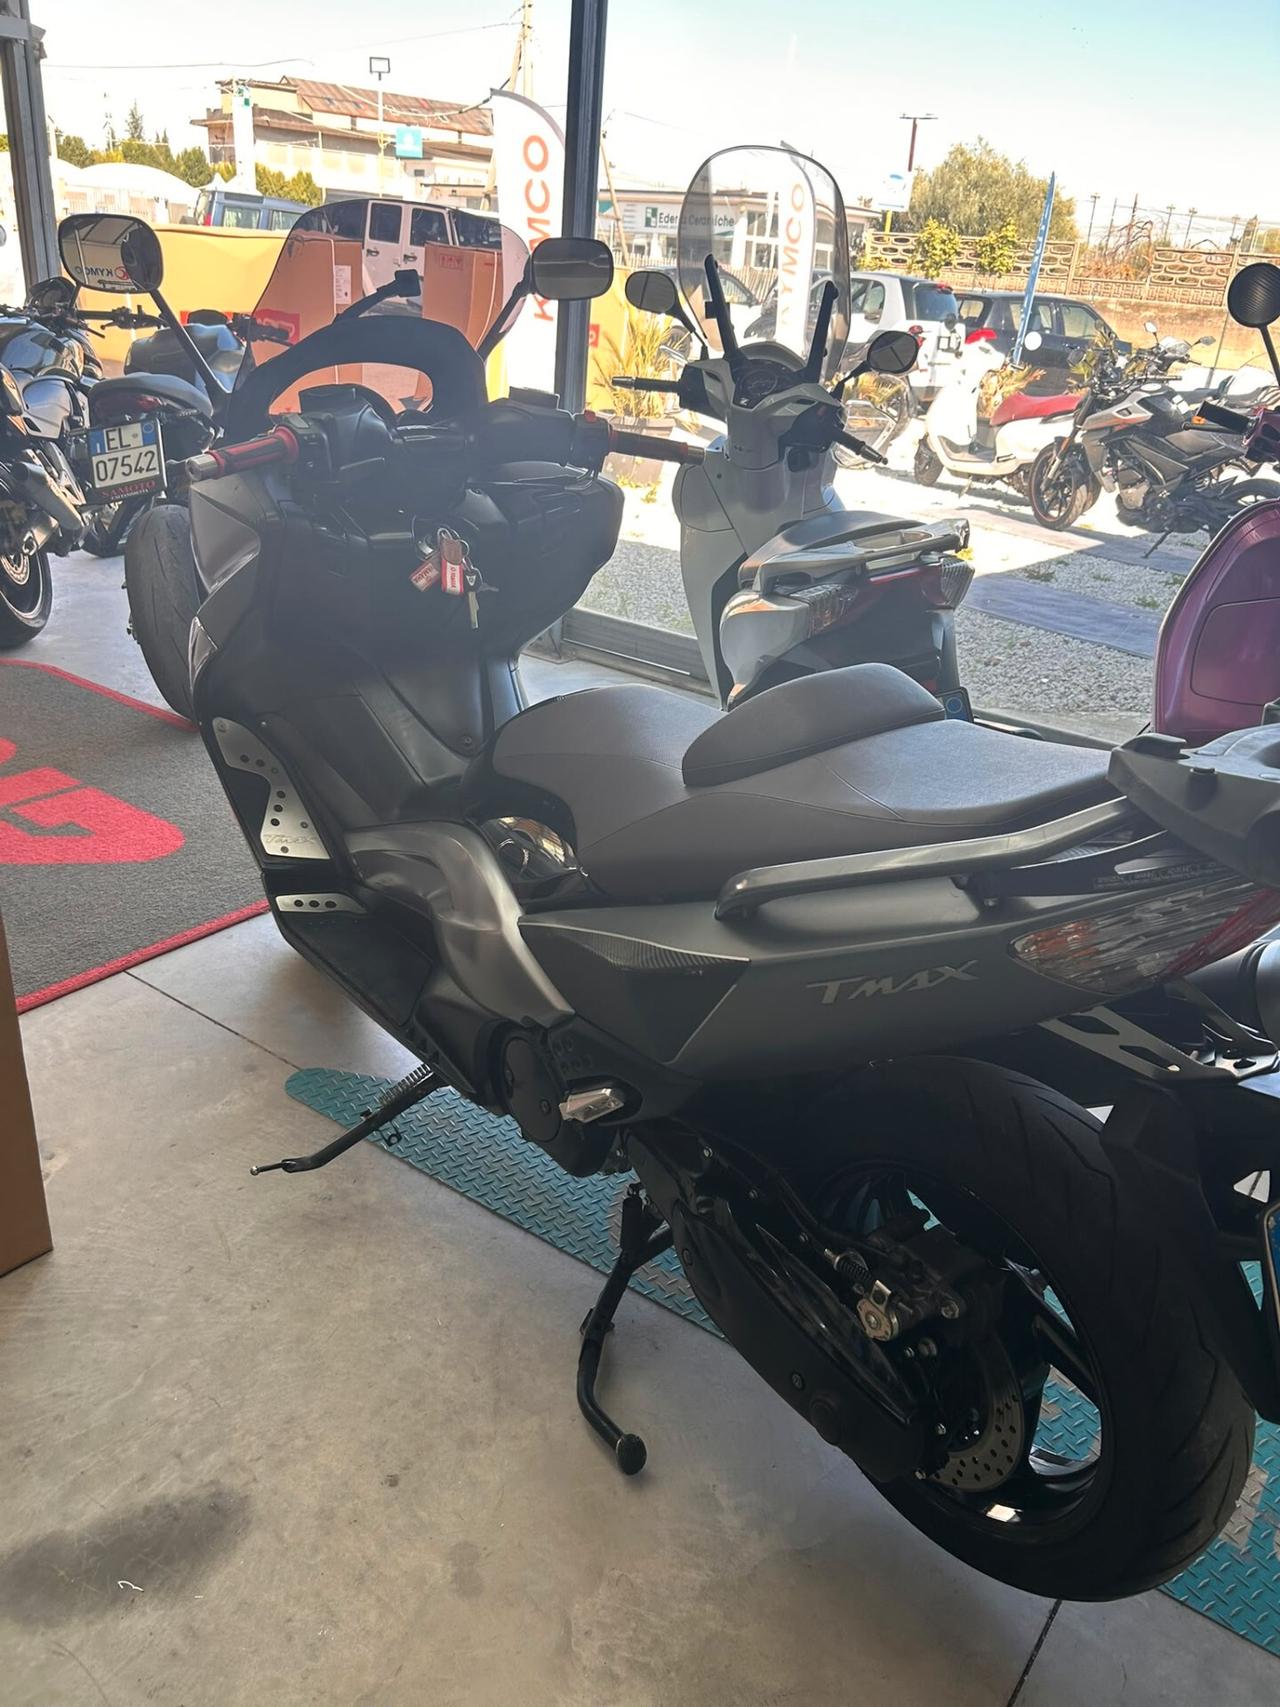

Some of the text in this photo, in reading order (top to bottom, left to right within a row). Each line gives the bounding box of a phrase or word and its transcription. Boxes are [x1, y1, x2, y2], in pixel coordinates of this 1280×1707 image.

[523, 134, 553, 321] KMCO
[106, 427, 131, 450] EL
[95, 450, 157, 482] 07542
[806, 959, 980, 1004] TMAX
